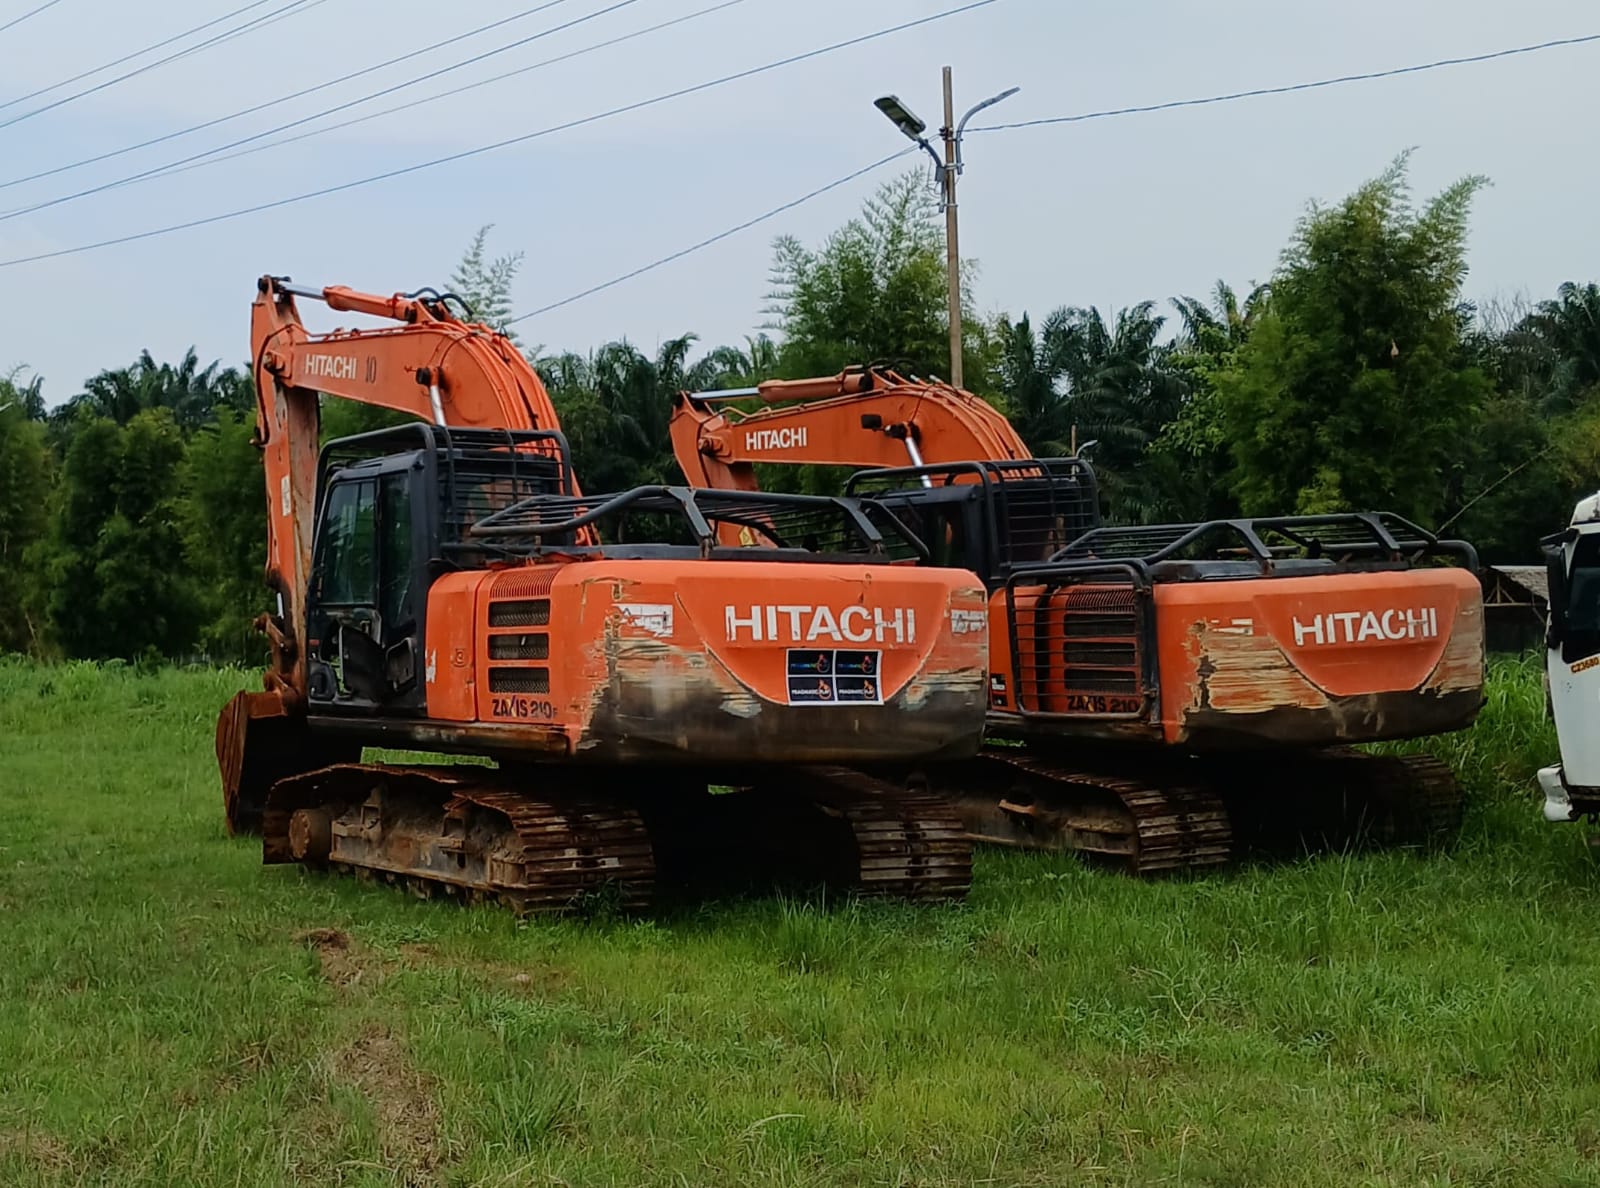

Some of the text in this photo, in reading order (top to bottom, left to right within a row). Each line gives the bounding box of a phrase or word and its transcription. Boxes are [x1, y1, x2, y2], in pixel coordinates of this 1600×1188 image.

[305, 353, 357, 380] HITACHI
[745, 427, 807, 451] HITACHI
[725, 605, 917, 643] HITACHI
[1293, 607, 1438, 646] HITACHI
